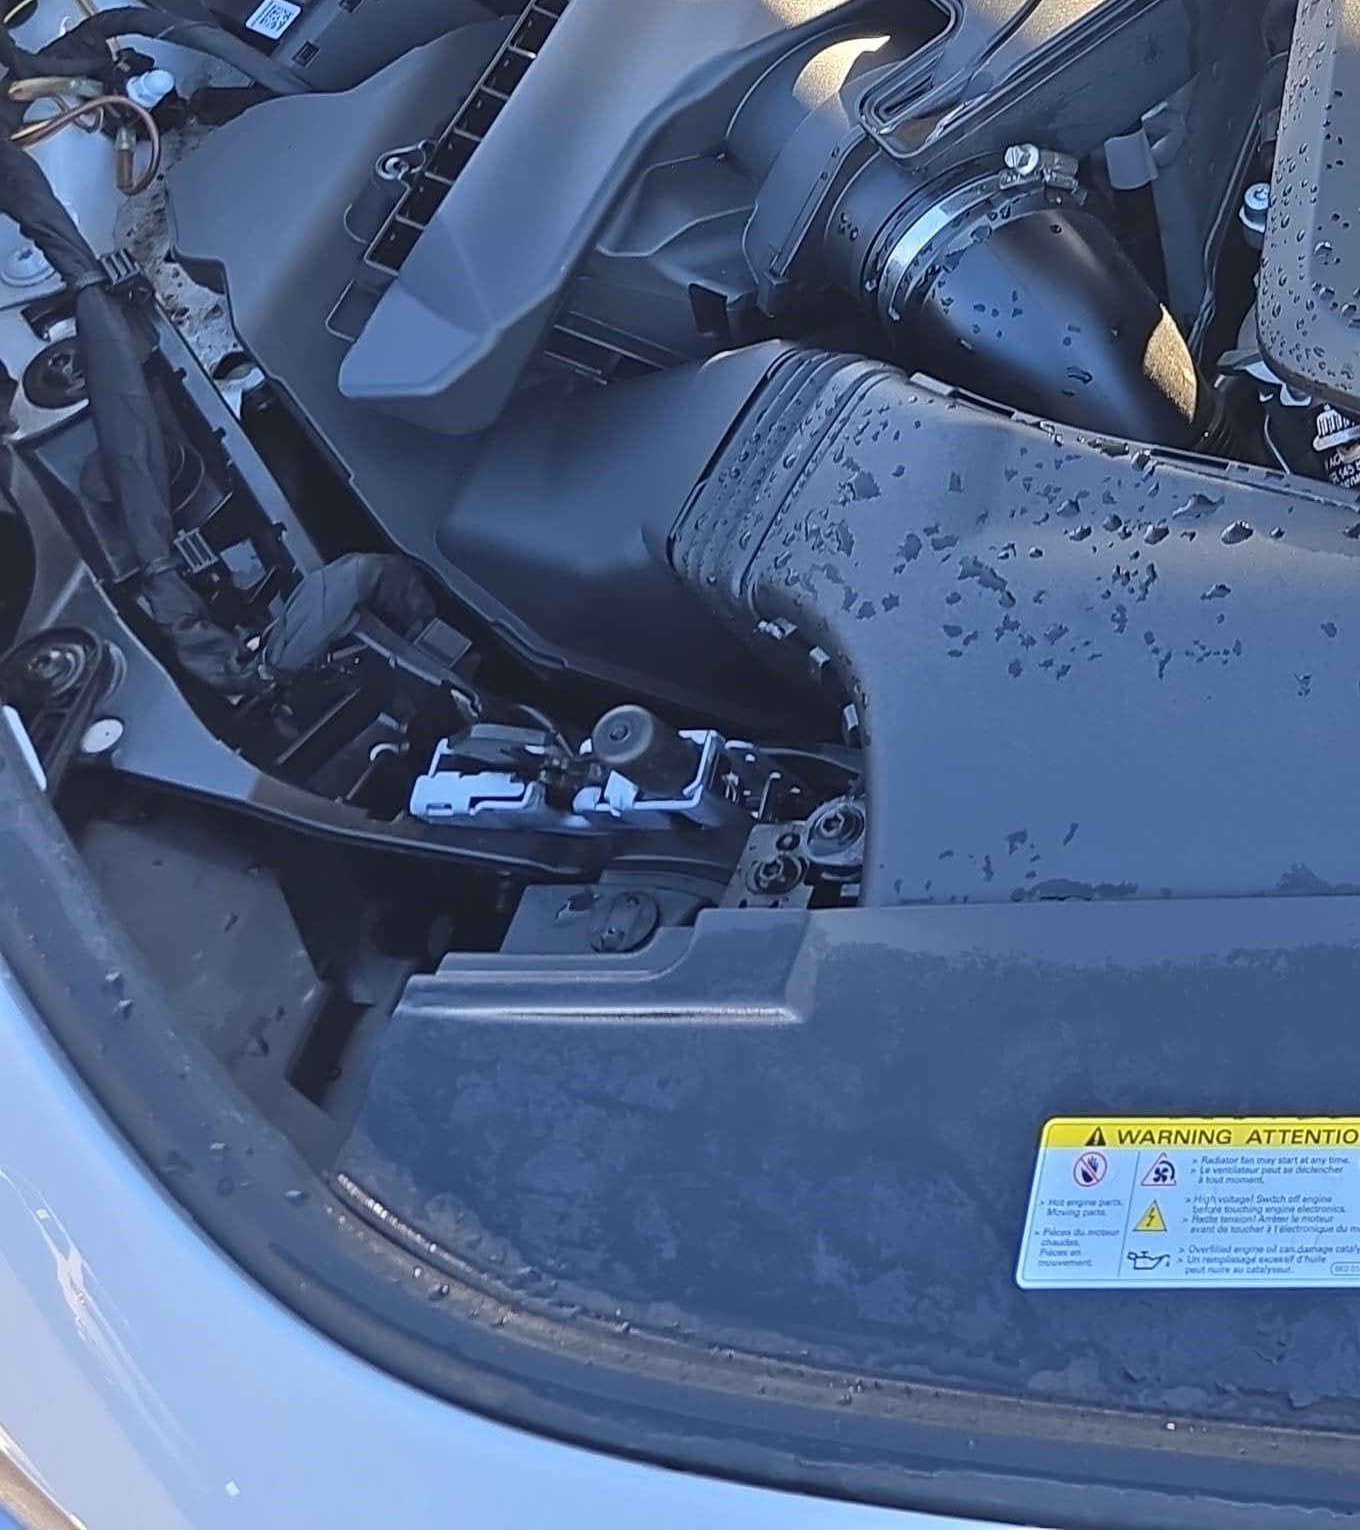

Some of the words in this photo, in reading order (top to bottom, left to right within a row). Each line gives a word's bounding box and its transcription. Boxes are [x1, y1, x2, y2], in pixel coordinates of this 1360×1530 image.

[1118, 1129, 1232, 1145] WARNING
[1201, 1156, 1238, 1164] Radiator
[1240, 1156, 1255, 1164] fan
[1256, 1157, 1276, 1166] may
[1310, 1157, 1327, 1166] any
[1193, 1195, 1217, 1207] High
